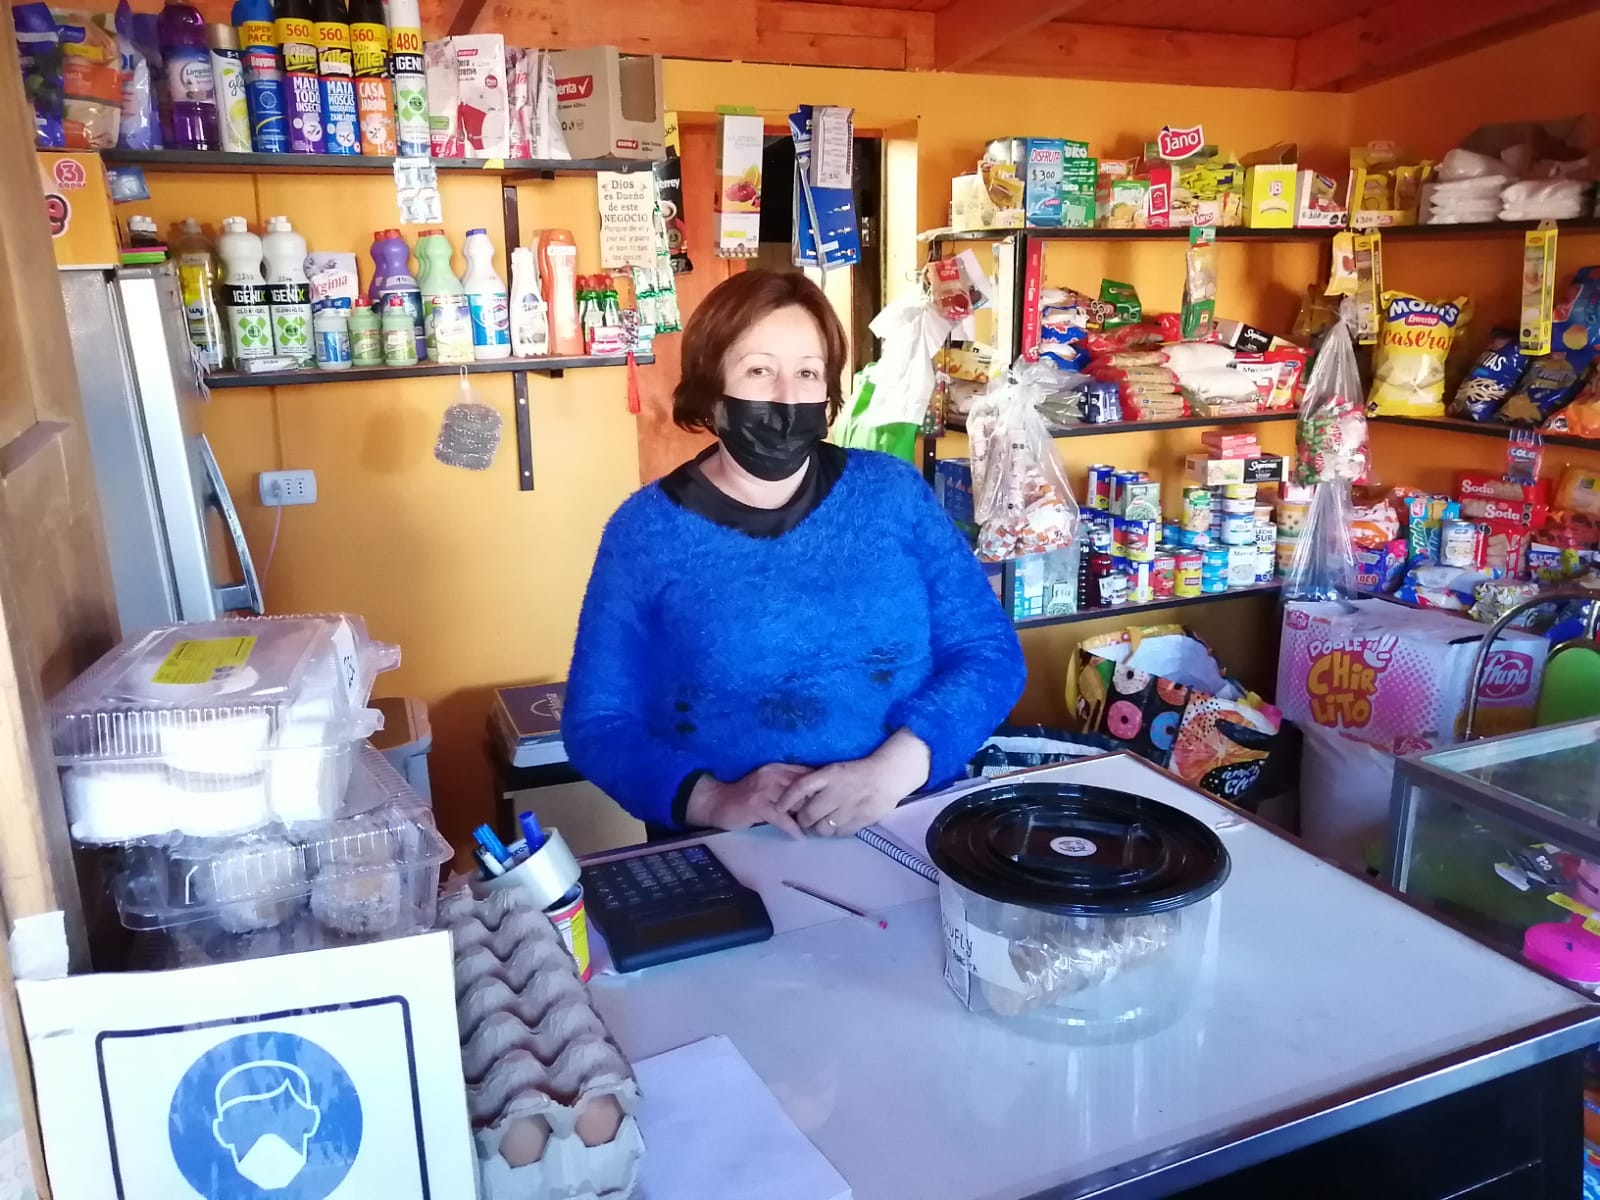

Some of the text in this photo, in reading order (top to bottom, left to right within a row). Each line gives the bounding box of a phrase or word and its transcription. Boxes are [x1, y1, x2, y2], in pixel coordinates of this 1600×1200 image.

[286, 23, 309, 37] 560
[319, 27, 342, 41] 560
[352, 28, 374, 41] 560
[248, 33, 272, 42] PACK
[396, 33, 418, 50] 480
[327, 81, 354, 94] MATA
[360, 82, 386, 97] CASA
[1164, 131, 1199, 154] Jano
[60, 162, 77, 182] 3
[1040, 169, 1056, 182] 300
[611, 180, 634, 190] Dios
[616, 191, 645, 200] Dueño
[608, 202, 639, 211] de este
[604, 213, 649, 223] NEGOCIO
[232, 289, 266, 304] IGENIX
[271, 288, 305, 303] IGENIX
[1461, 479, 1494, 495] Soda
[1484, 503, 1521, 520] Soda
[1255, 534, 1273, 542] SUR
[1480, 653, 1529, 688] fruna
